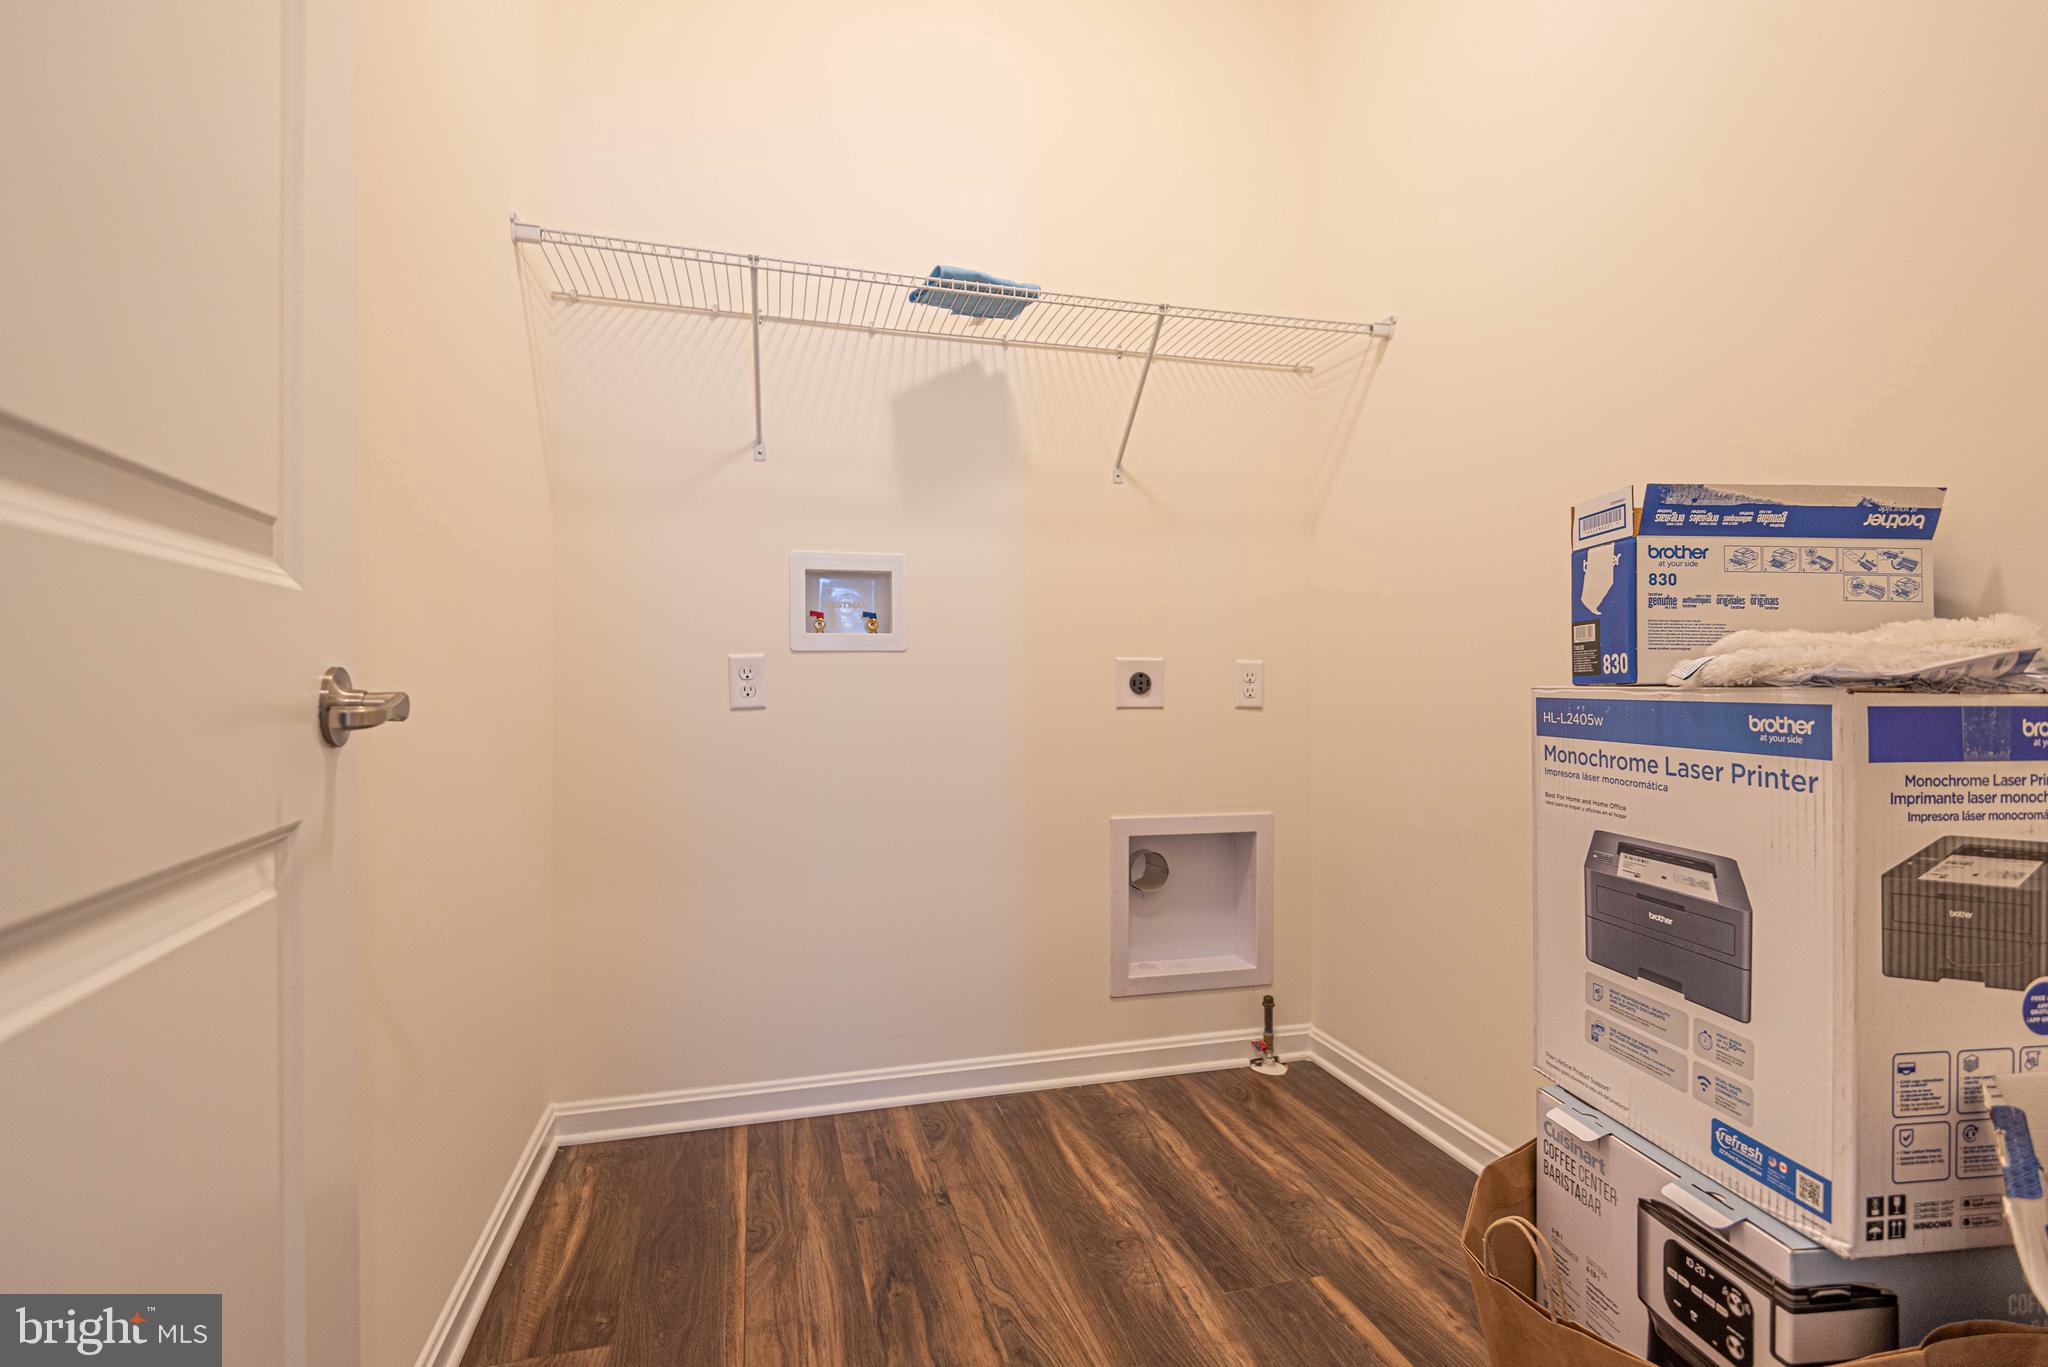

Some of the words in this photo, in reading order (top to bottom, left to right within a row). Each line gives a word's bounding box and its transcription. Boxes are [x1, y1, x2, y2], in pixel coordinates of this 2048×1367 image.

[1757, 511, 1788, 526] genuine
[1863, 513, 1926, 529] brother
[1648, 544, 1709, 559] brother
[1648, 572, 1677, 586] 830
[1648, 594, 1678, 608] genuine
[1603, 652, 1628, 674] 830
[1748, 715, 1815, 735] brother
[1760, 734, 1767, 742] at
[1768, 736, 1785, 745] your
[1786, 735, 1803, 744] side
[1544, 744, 1659, 774] Monochrome
[1665, 756, 1724, 782] Laser
[1731, 763, 1819, 794] Printer
[1544, 768, 1580, 780] Impresora
[1582, 772, 1600, 782] láser
[1602, 776, 1668, 792] monocromática
[1905, 774, 1989, 787] Monochrome
[1993, 774, 2027, 786] Laser
[1565, 795, 1580, 803] Home
[1592, 799, 1608, 808] Home
[1890, 792, 1964, 806] Imprimante
[1968, 791, 1997, 804] laser
[1908, 811, 1959, 823] Impresora
[1962, 810, 1985, 821] láser
[1648, 911, 1673, 925] brother
[1950, 910, 1973, 919] brother
[1544, 1120, 1606, 1176] Cuisinart
[1718, 1131, 1763, 1162] refresh
[1544, 1139, 1576, 1176] COFFEE
[1579, 1164, 1616, 1206] CENTER
[1544, 1159, 1602, 1216] BARISTABAR
